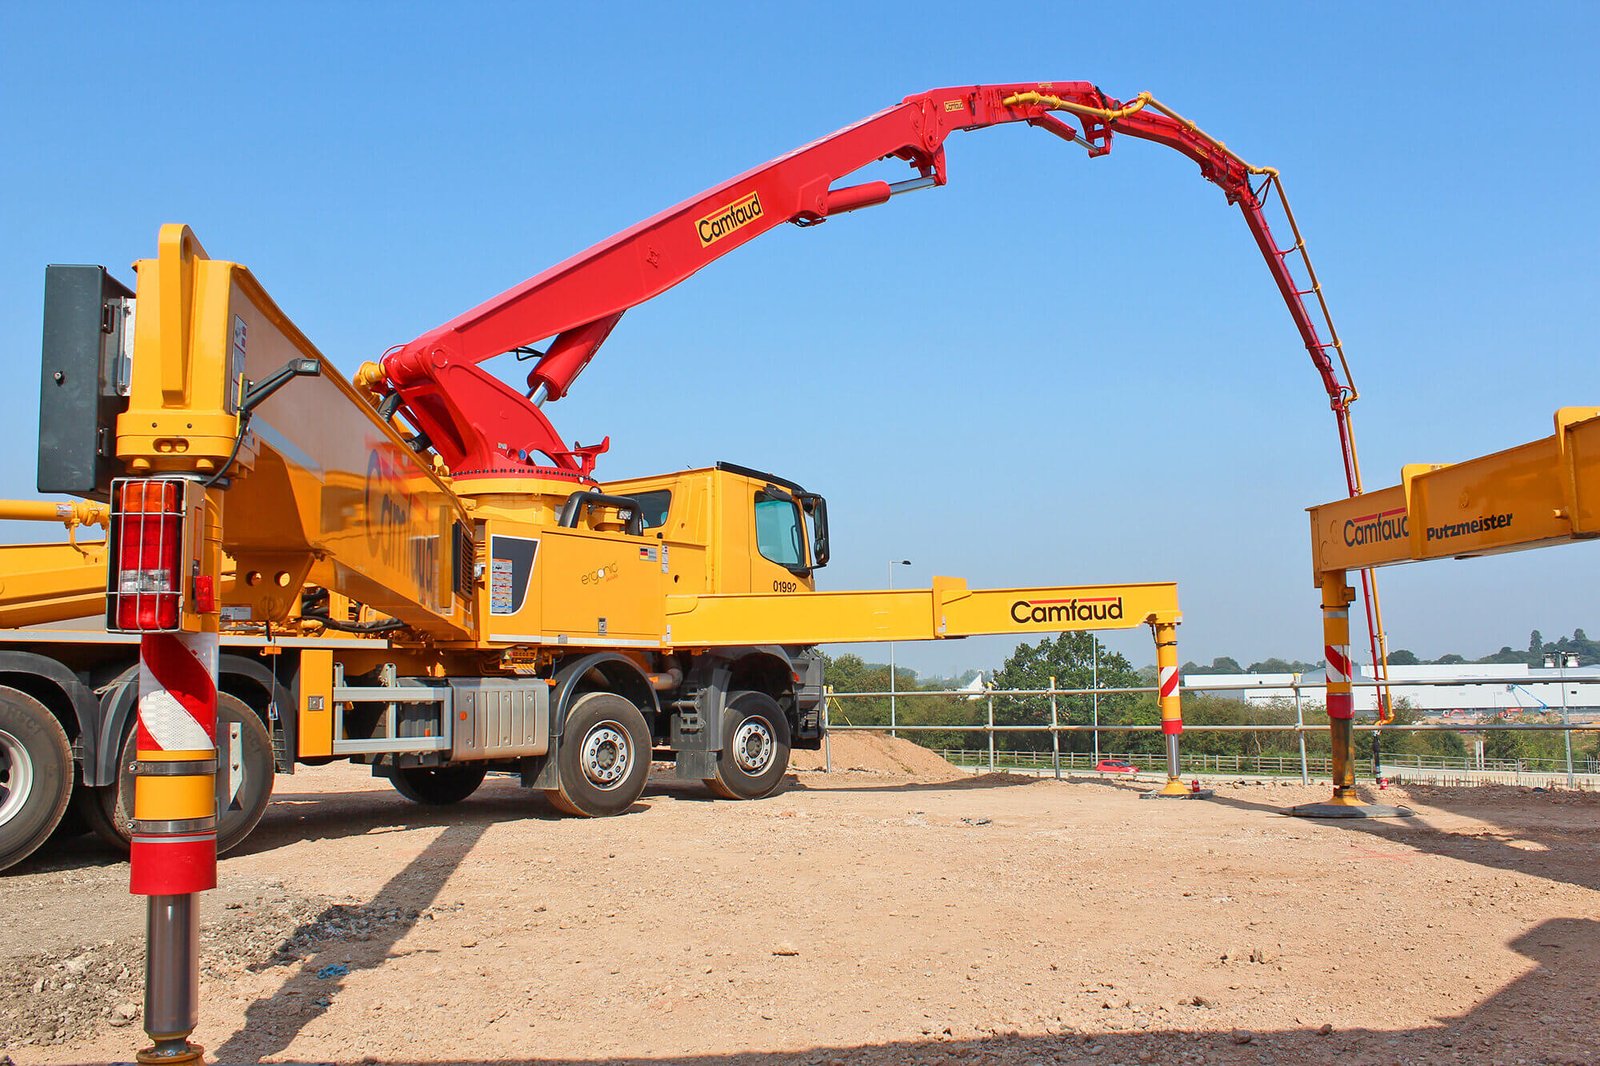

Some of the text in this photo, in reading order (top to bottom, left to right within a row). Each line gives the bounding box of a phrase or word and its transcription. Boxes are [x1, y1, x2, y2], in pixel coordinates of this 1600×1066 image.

[699, 193, 762, 243] Camfaud
[1427, 513, 1513, 541] Putzmeister
[773, 580, 797, 593] 01992
[1011, 597, 1122, 624] Camfaud
